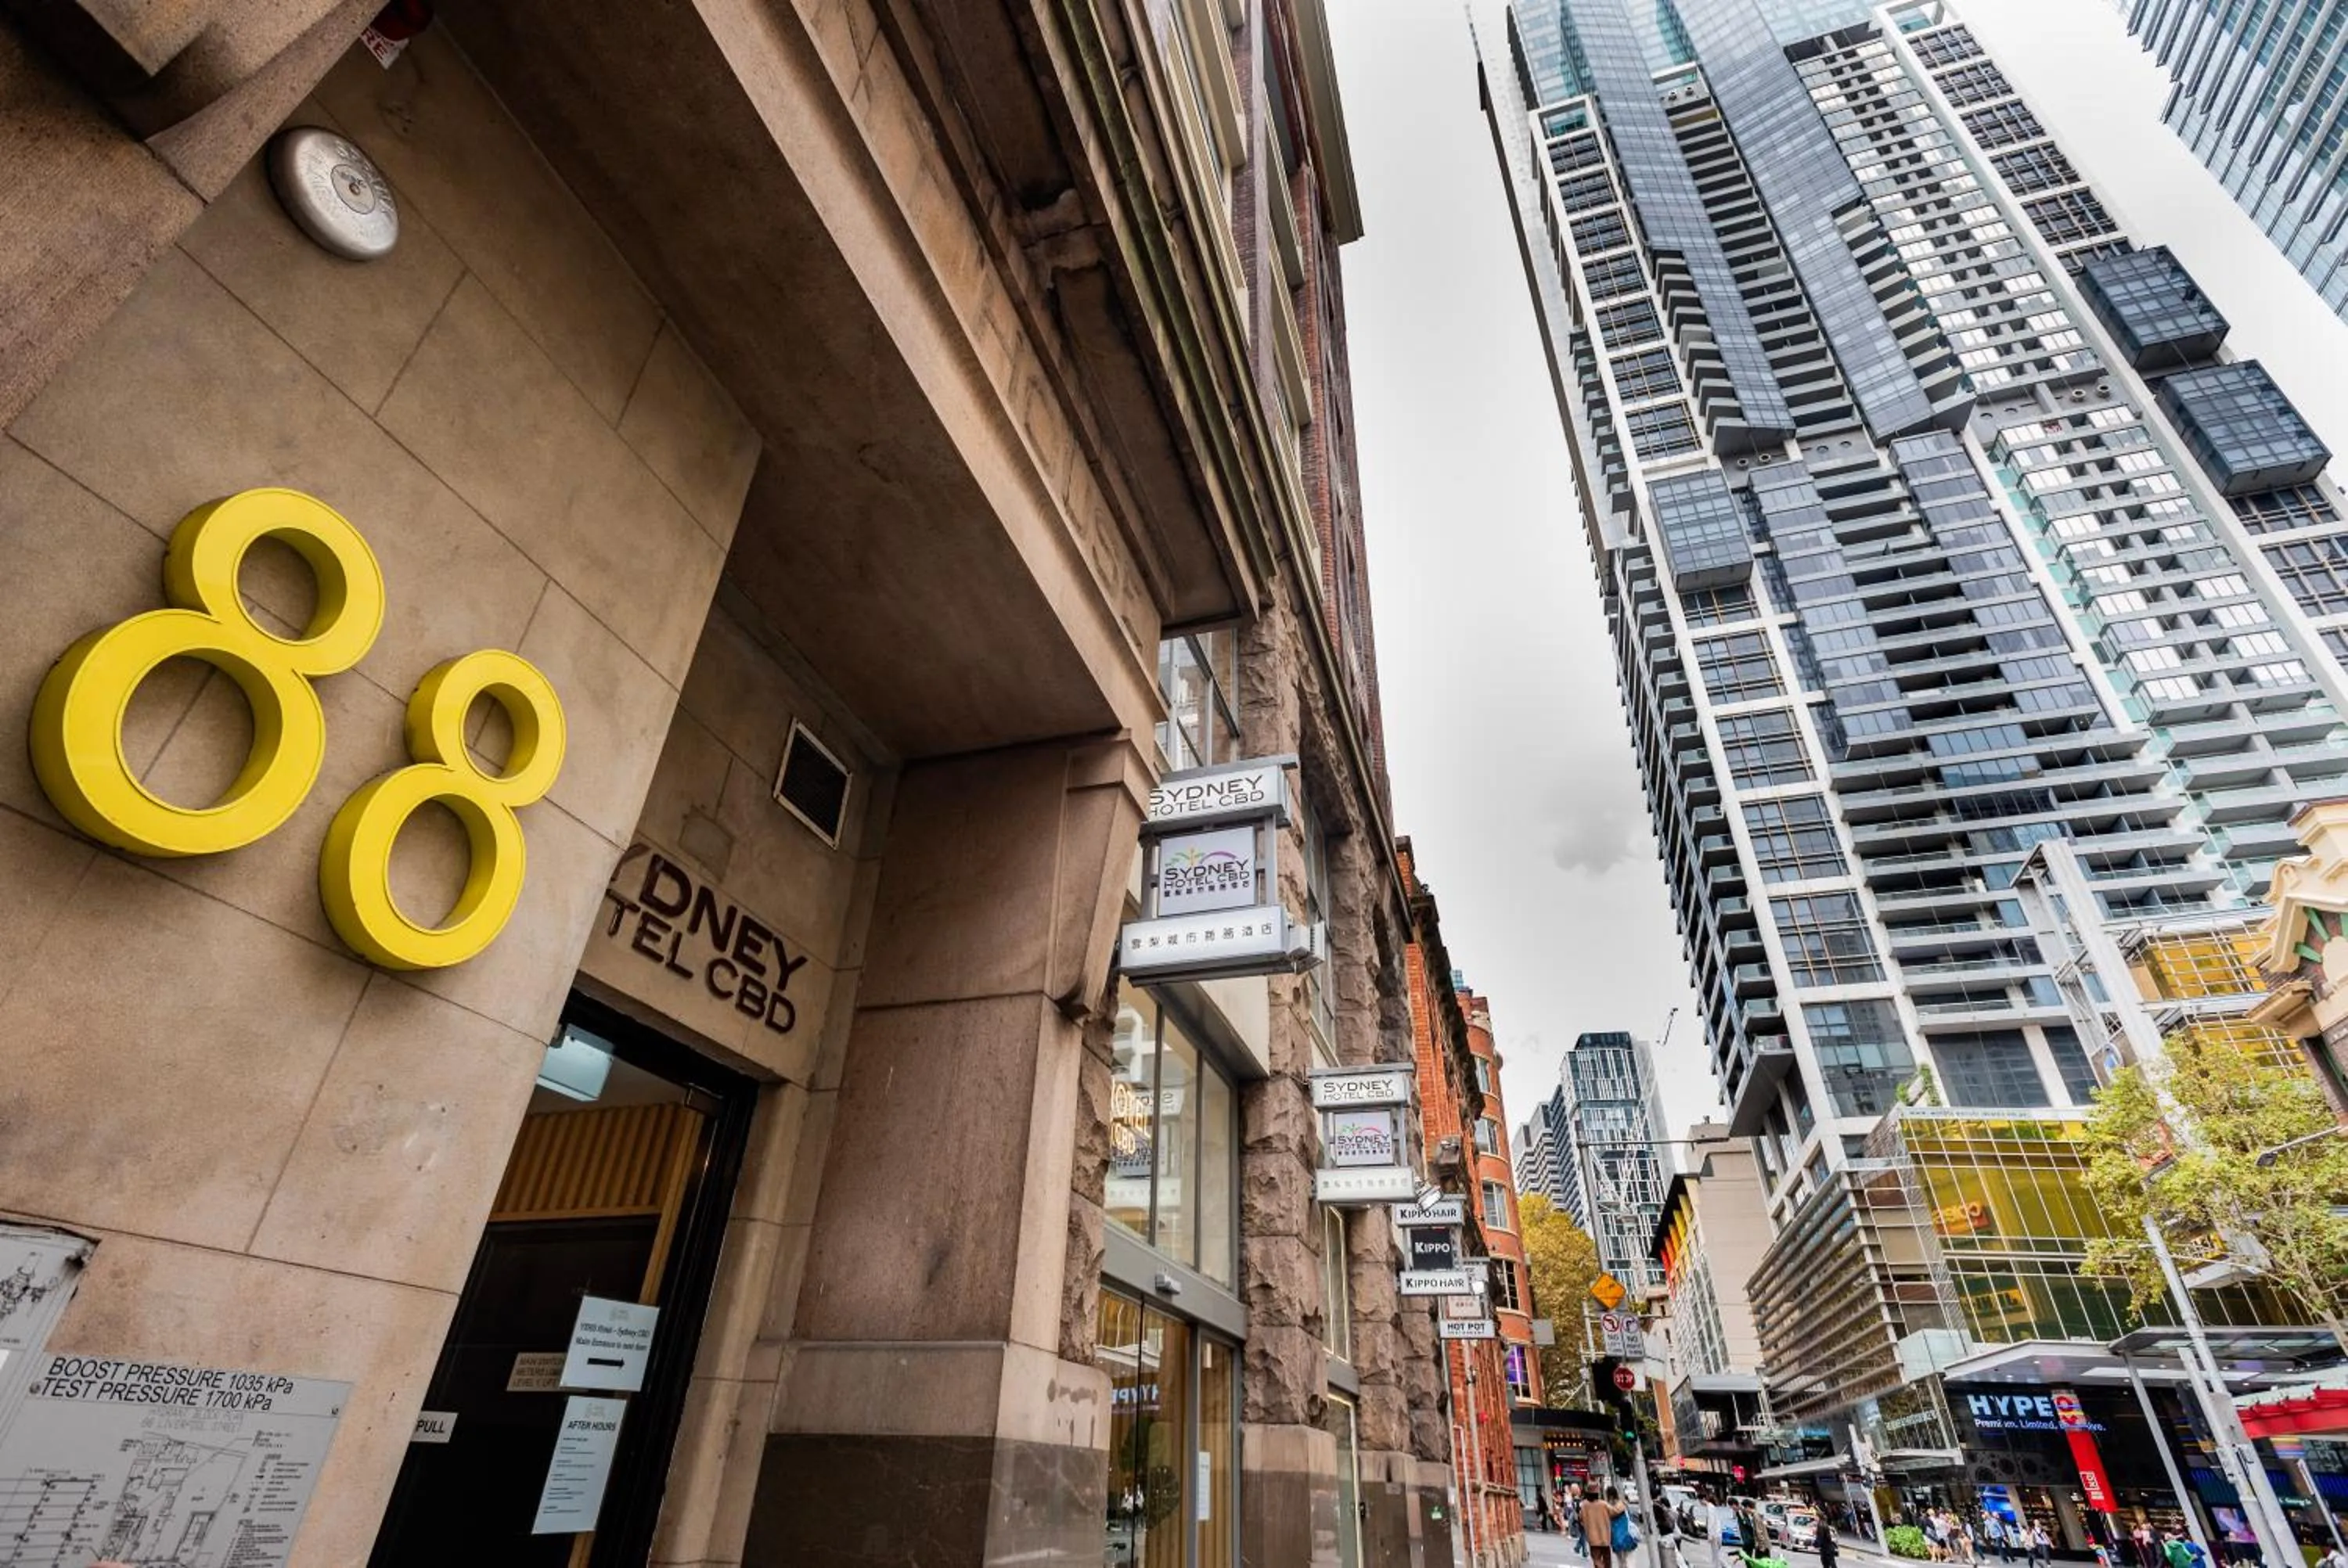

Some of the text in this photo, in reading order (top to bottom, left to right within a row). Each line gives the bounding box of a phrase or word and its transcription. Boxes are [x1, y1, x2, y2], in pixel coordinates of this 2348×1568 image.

[361, 27, 388, 60] RE
[28, 487, 567, 970] 88
[1150, 775, 1263, 804] SYDNEY
[1219, 791, 1265, 807] CBD
[1164, 860, 1249, 880] SYDNEY
[1164, 876, 1215, 890] HOTEL
[1217, 870, 1250, 883] CBD
[610, 842, 808, 991] YDNEY
[605, 888, 796, 1034] TEL CBD
[1323, 1080, 1393, 1093] SYDNEY
[1323, 1089, 1394, 1101] HOTEL CBD
[1338, 1135, 1390, 1145] SYDNEY
[1400, 1208, 1457, 1218] KIPPO HAIR
[1414, 1241, 1450, 1254] KIPPO
[1406, 1278, 1464, 1289] KIPPO HAIR
[49, 1357, 294, 1394] BOOST PRESSURE 1035 kPa
[41, 1377, 273, 1411] TEST PRESSURE 1700 kPa
[1967, 1394, 2054, 1417] HYPE
[416, 1419, 445, 1434] PULL
[567, 1420, 617, 1432] AFTER HOURS
[2019, 1419, 2058, 1430] Limited.
